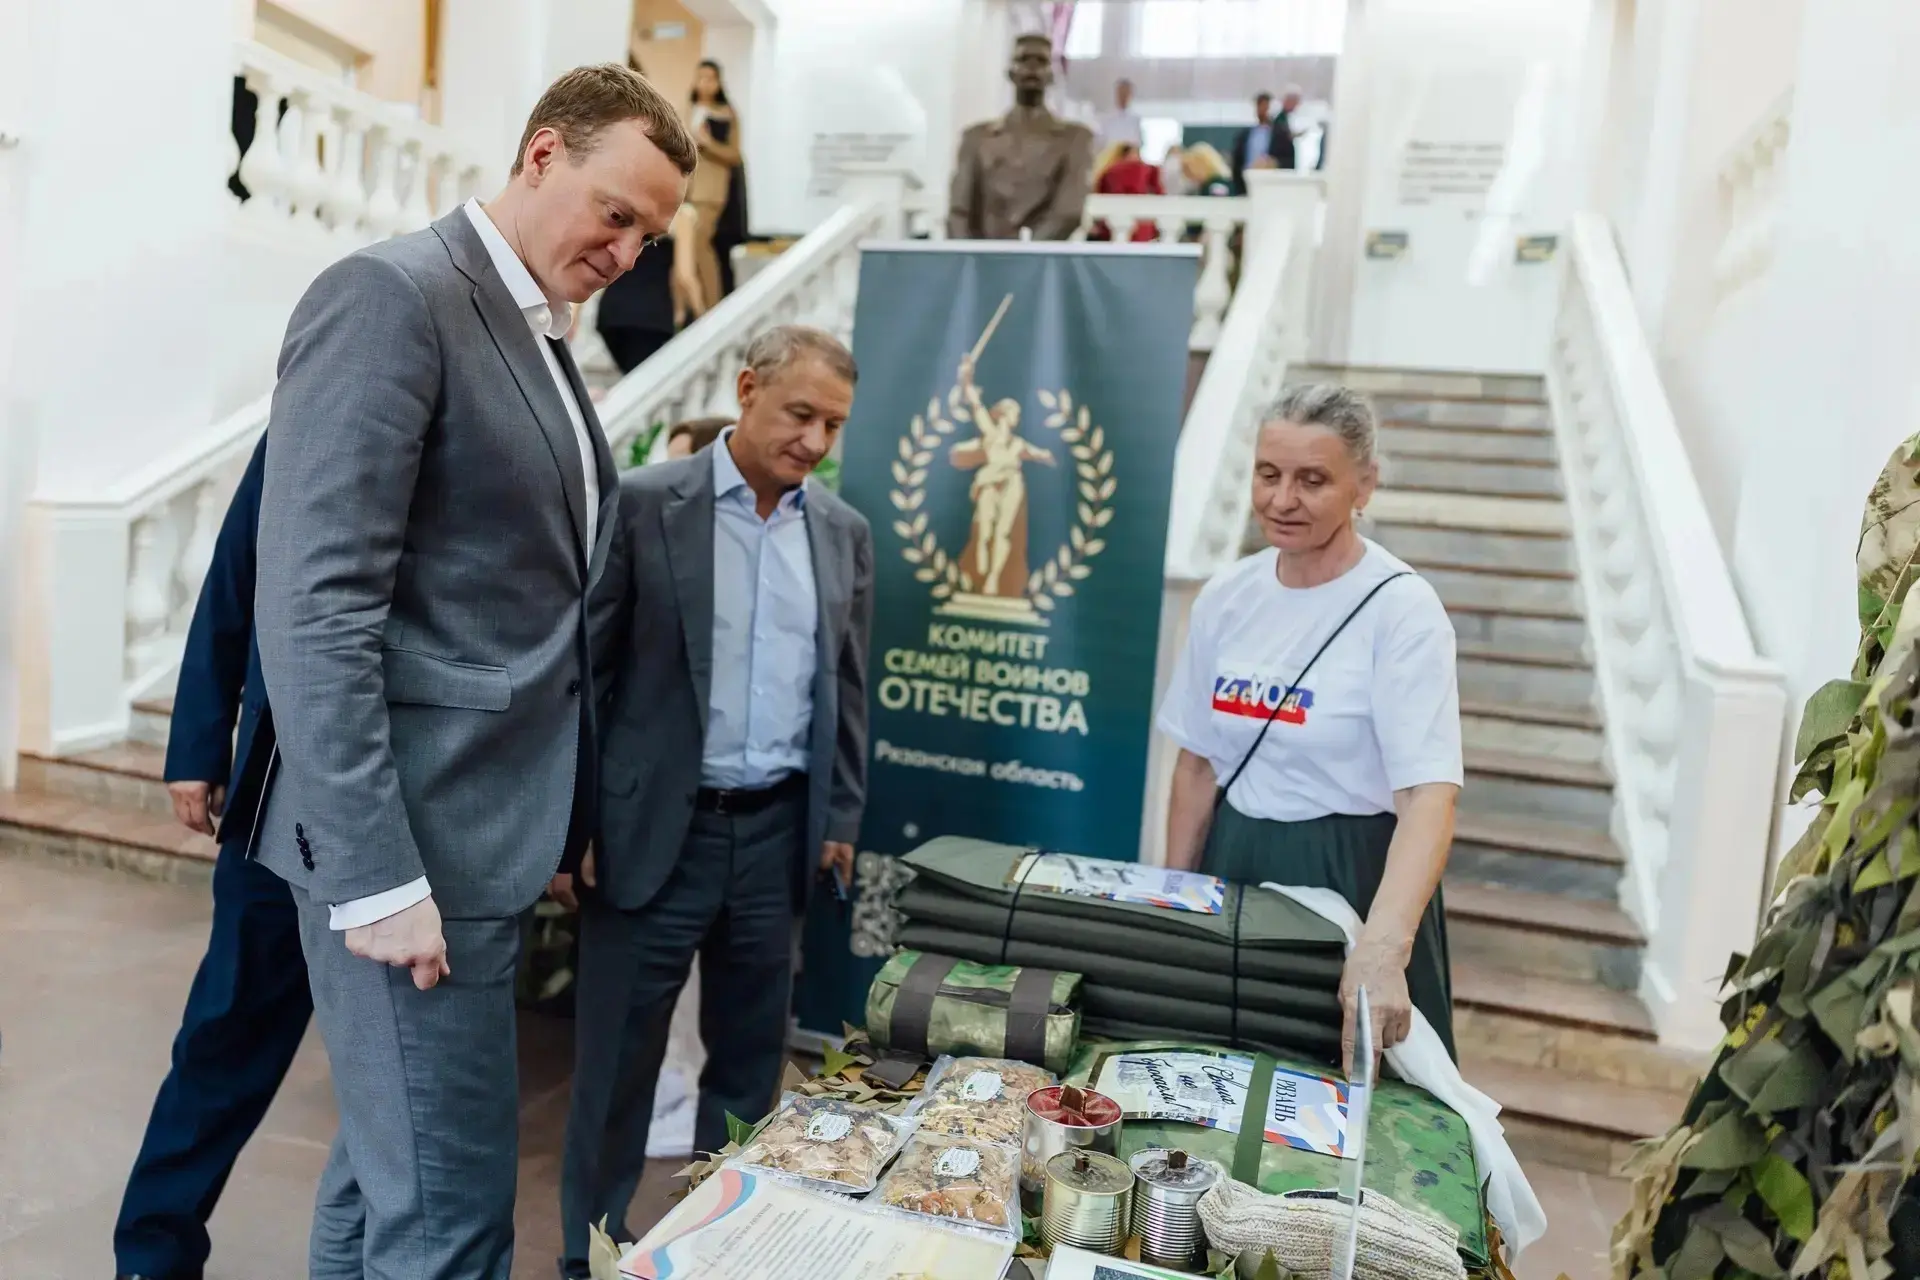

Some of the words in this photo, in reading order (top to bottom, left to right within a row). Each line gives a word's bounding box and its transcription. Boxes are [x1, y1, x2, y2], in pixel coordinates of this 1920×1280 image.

[929, 624, 1049, 659] КОМИТЕТ
[884, 648, 970, 679] СЕМЕЙ
[974, 659, 1090, 697] ВОИНОВ
[878, 676, 1089, 736] ОТЕЧЕСТВА
[874, 739, 986, 776] Рязанская
[990, 760, 1084, 792] область
[1179, 1074, 1198, 1089] не
[1201, 1065, 1249, 1105] Своих
[1274, 1078, 1297, 1122] РЯЗАНЬ
